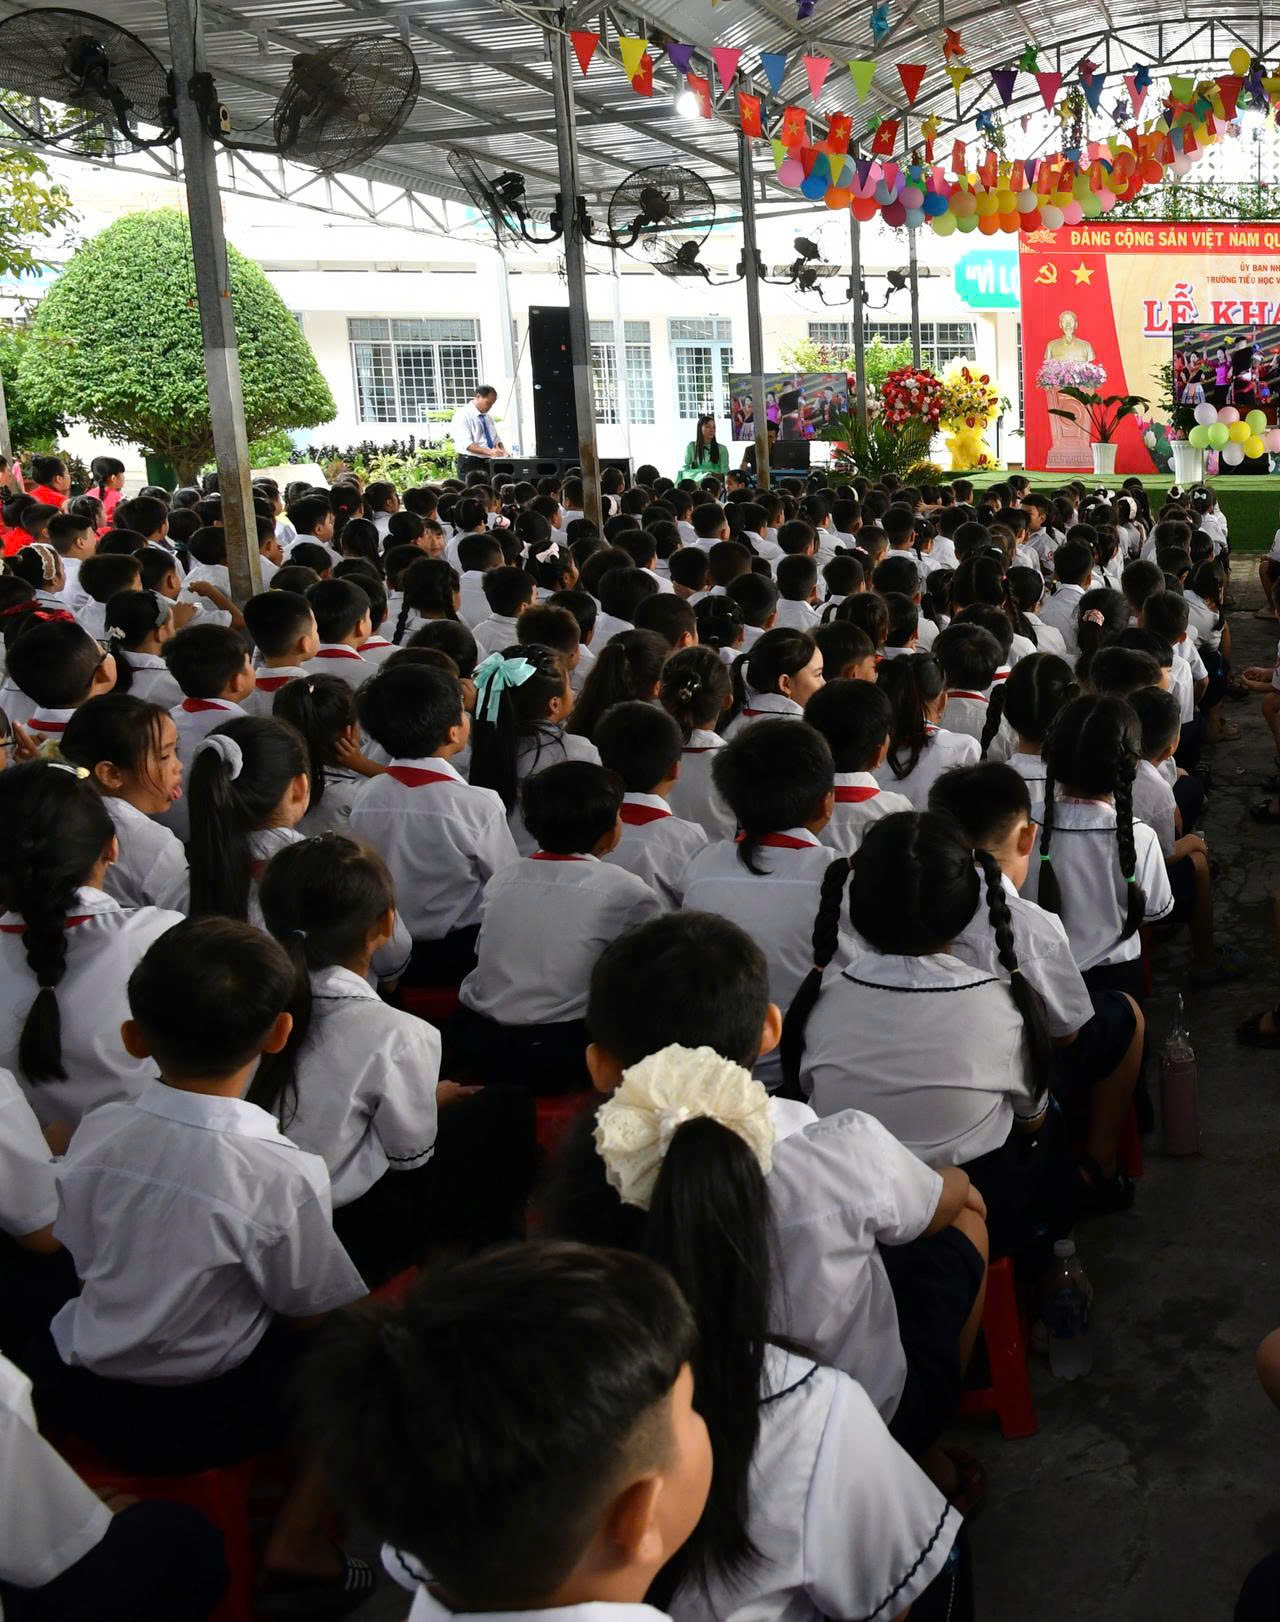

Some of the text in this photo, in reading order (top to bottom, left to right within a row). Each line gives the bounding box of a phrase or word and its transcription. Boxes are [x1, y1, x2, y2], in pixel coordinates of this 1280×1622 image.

[1071, 226, 1111, 246] ĐẢNG
[1114, 227, 1154, 249] CỘNG
[1158, 227, 1188, 246] SẢN
[1192, 227, 1224, 249] VIỆT
[1229, 231, 1260, 247] NAM
[1240, 261, 1250, 272] ỦY
[1252, 264, 1268, 272] BAN
[1206, 274, 1237, 284] TRƯỜNG
[1238, 273, 1256, 284] TIỂU
[1258, 276, 1274, 285] HỌC
[1143, 283, 1197, 333] LỄ
